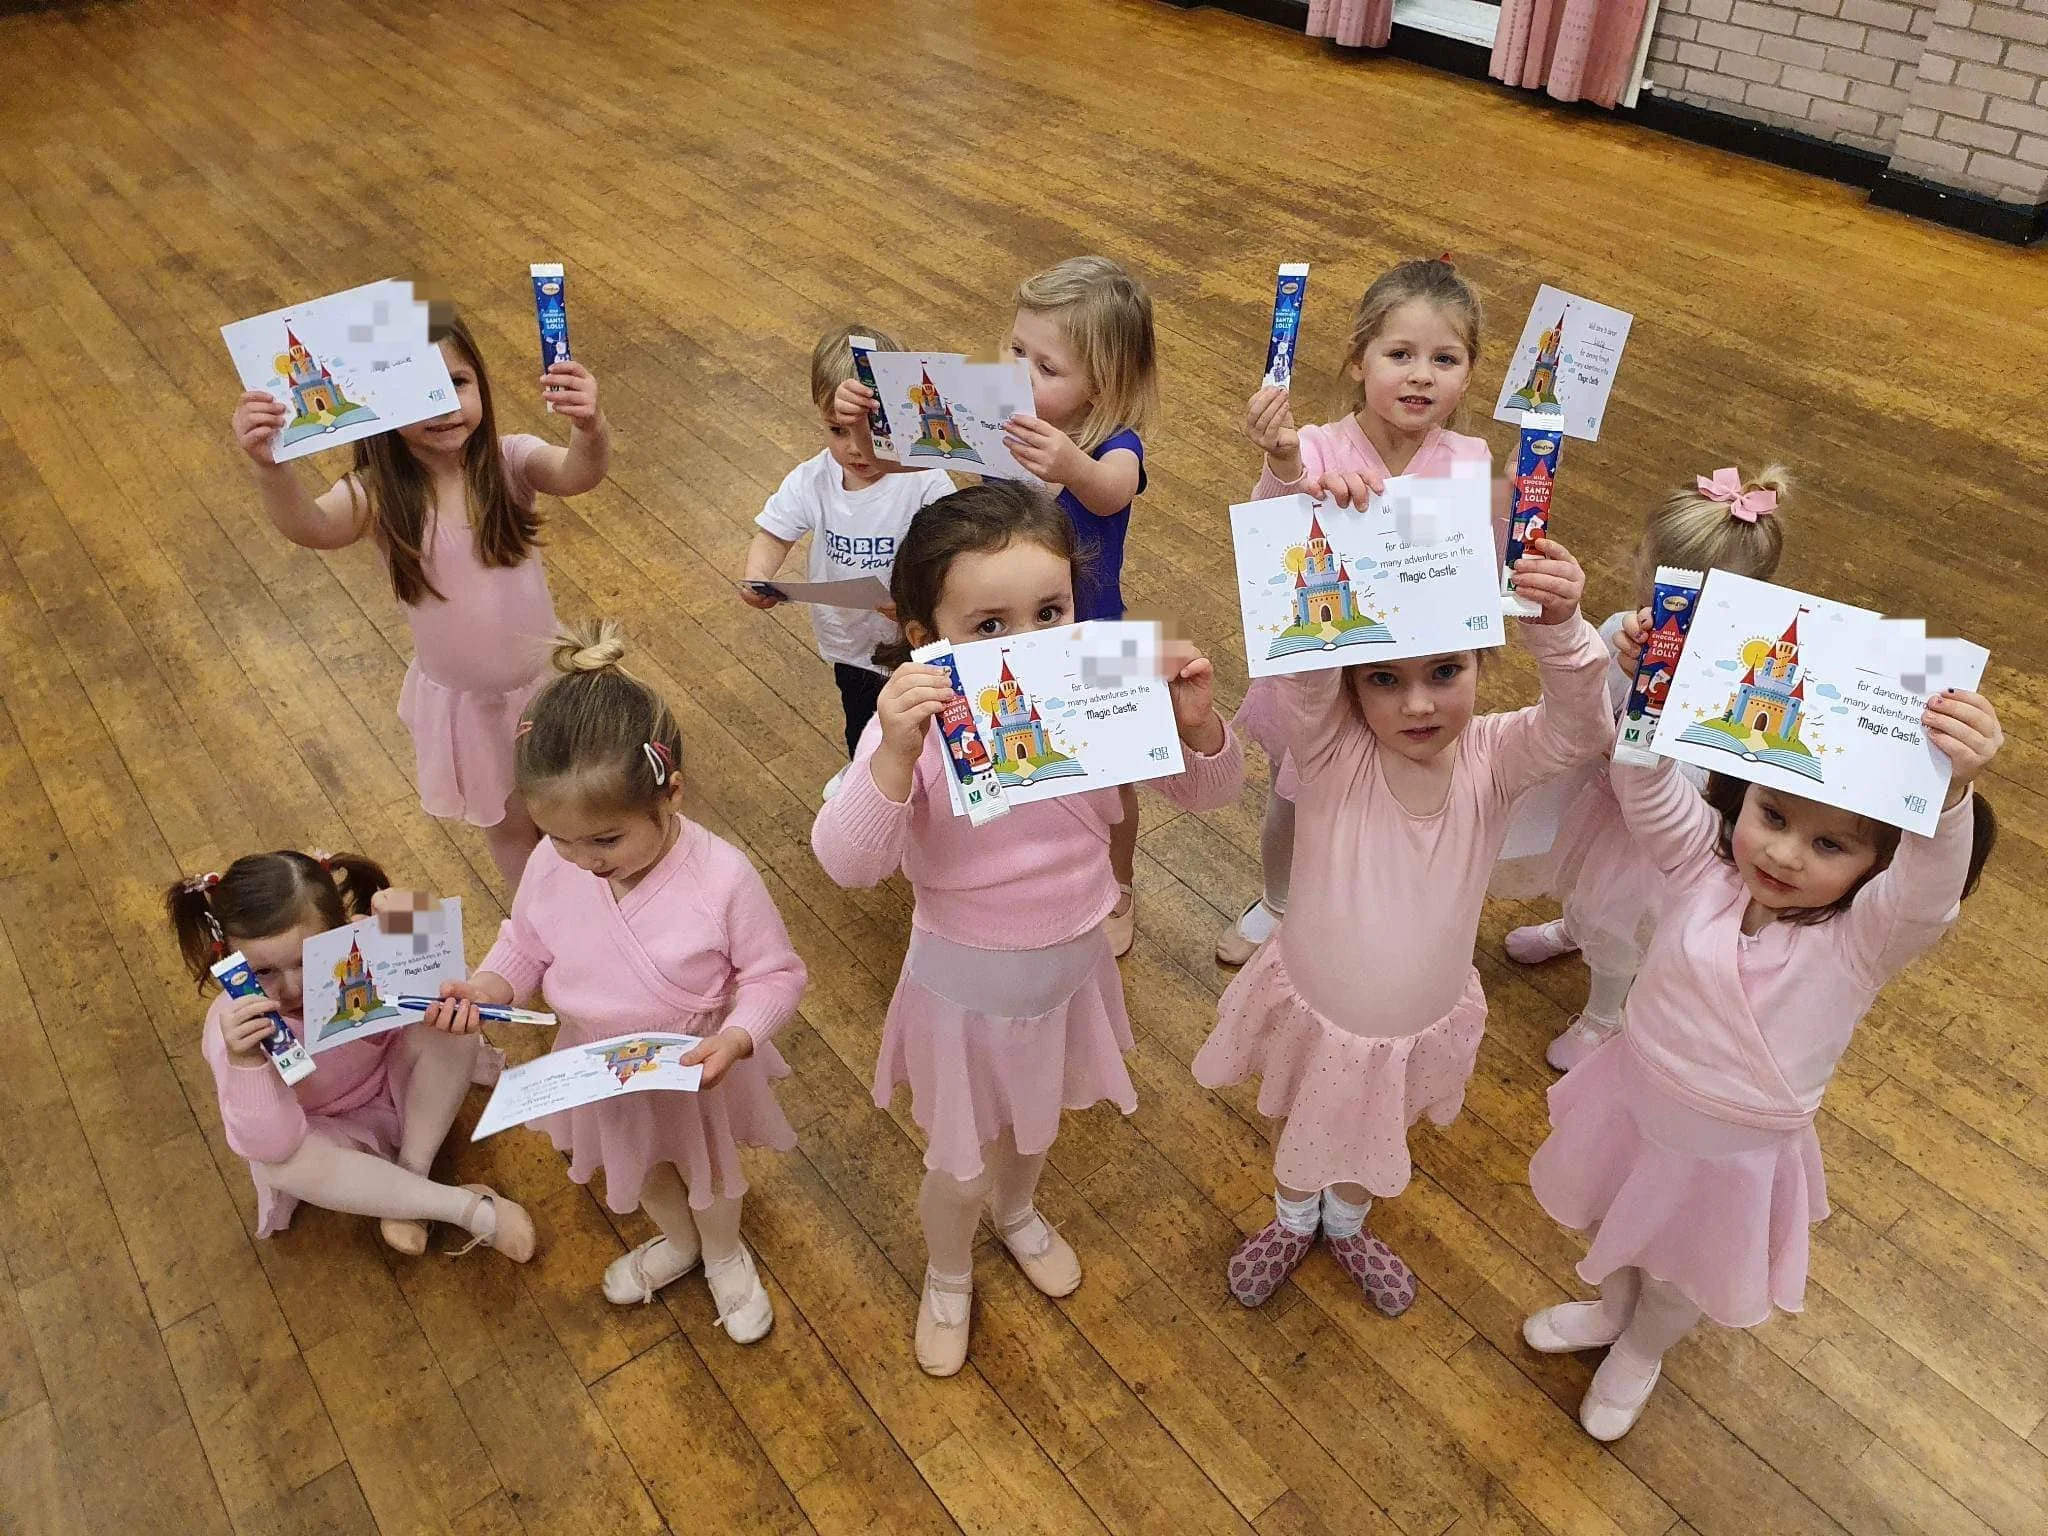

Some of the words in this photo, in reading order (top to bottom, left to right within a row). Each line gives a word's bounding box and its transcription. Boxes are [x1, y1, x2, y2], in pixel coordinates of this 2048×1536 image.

[1525, 486, 1550, 495] SANTA
[1525, 495, 1549, 503] LOLLY
[1385, 542, 1396, 552] for
[1380, 559, 1402, 568] many
[1405, 552, 1448, 564] adventures
[1460, 546, 1473, 556] the
[1652, 640, 1679, 651] SANTA
[1652, 647, 1677, 659] LOLLY
[1068, 699, 1087, 708] many
[1090, 690, 1128, 703] adventures
[1857, 680, 1871, 691] for
[1873, 686, 1908, 705] dancing
[1911, 696, 1929, 710] thro
[943, 704, 967, 717] SANTA
[1843, 697, 1869, 710] many
[1872, 705, 1920, 724] adventures
[947, 711, 968, 723] LOLLY
